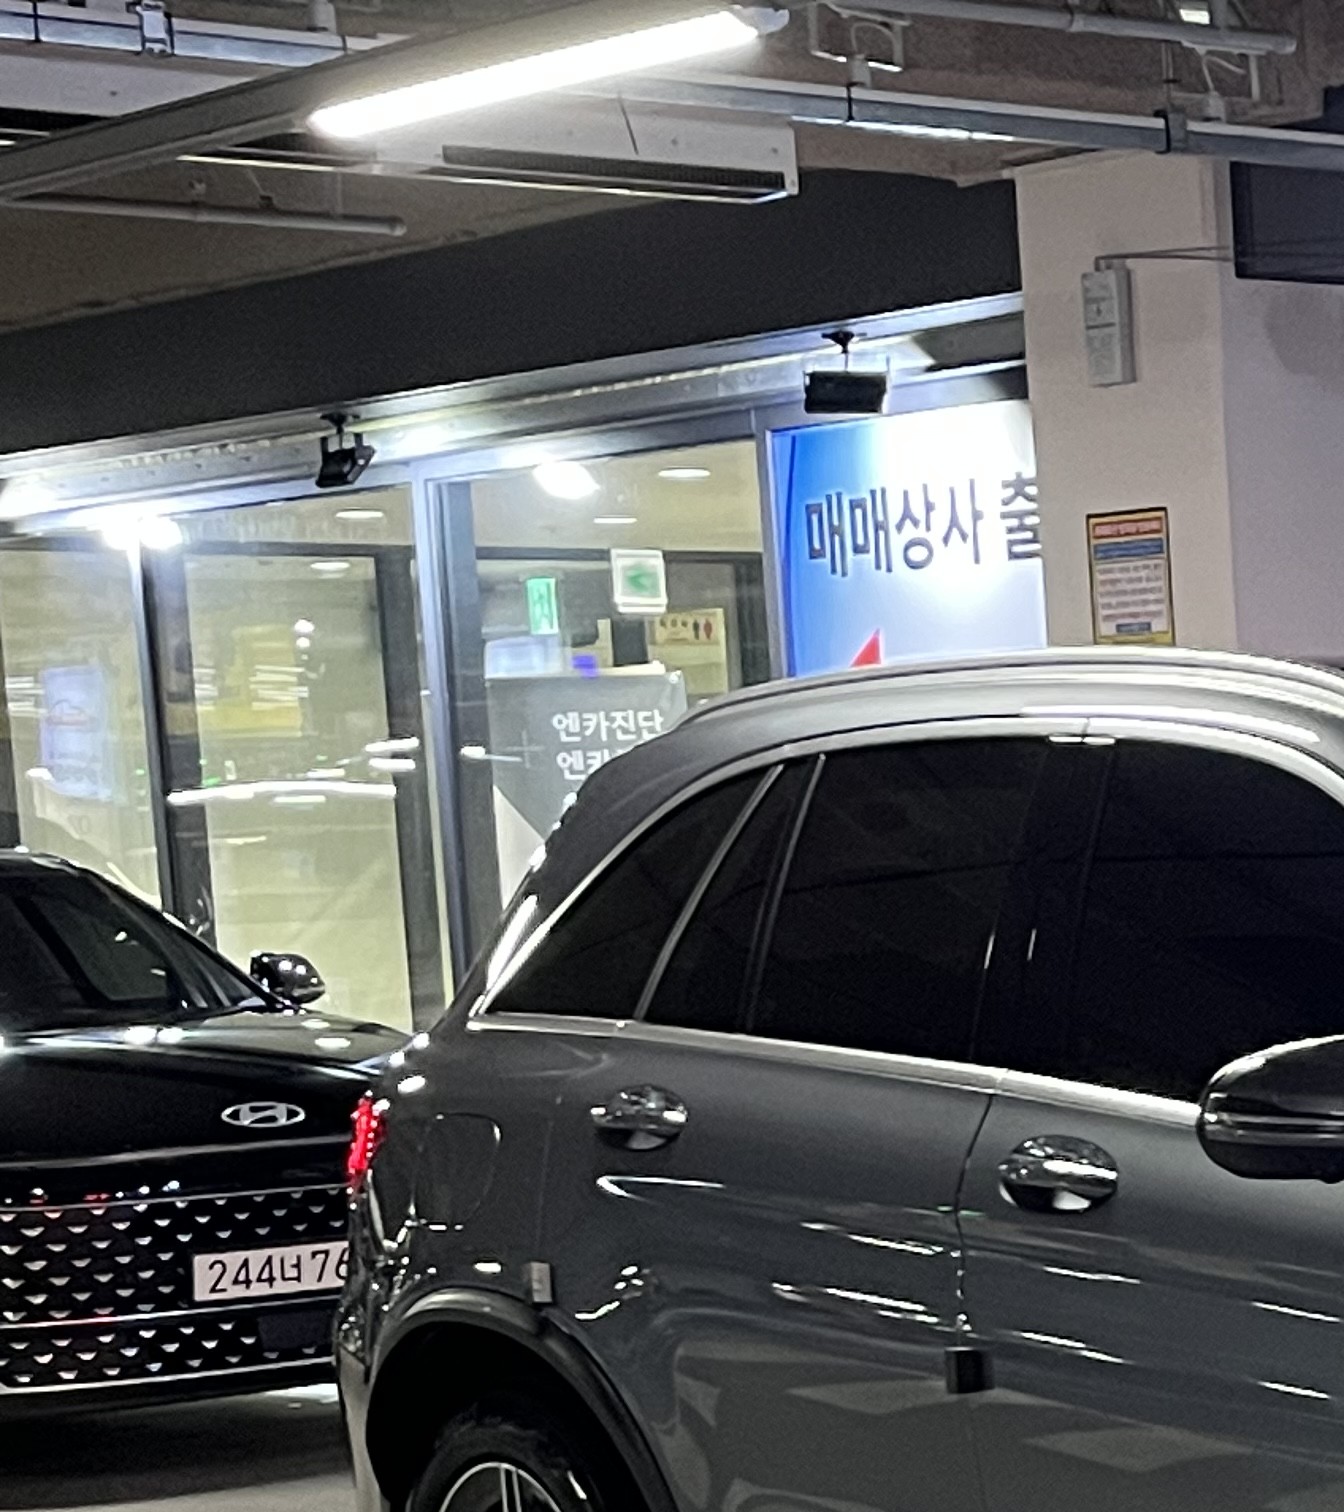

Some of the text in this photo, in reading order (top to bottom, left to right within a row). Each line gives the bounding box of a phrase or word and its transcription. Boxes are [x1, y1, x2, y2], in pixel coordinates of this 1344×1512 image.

[804, 478, 984, 578] 매매상사
[552, 708, 664, 743] 엔카진단
[208, 1254, 302, 1294] 244너
